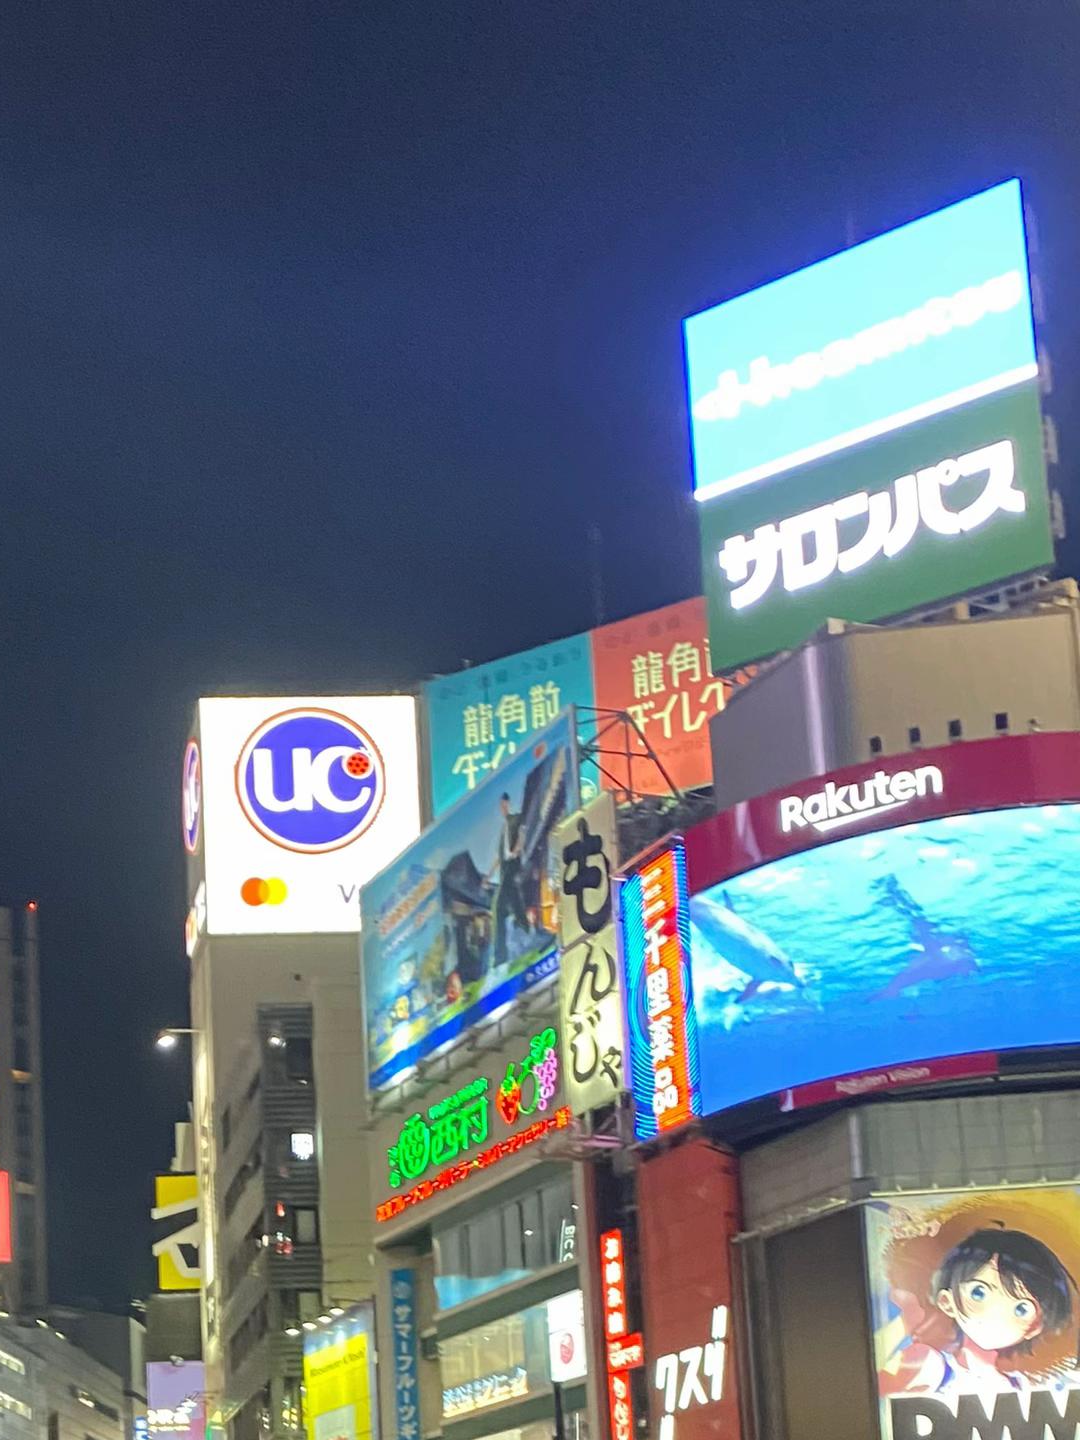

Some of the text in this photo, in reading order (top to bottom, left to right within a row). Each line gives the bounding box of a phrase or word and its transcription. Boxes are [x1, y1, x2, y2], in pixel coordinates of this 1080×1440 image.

[719, 440, 1026, 610] サロンパス
[631, 638, 715, 700] 龍角
[463, 681, 561, 748] 龍角散
[780, 765, 944, 833] Rakuten
[562, 816, 622, 1089] もんじゃ
[640, 866, 679, 1116] 三千里薬品
[564, 1224, 576, 1249] BIC
